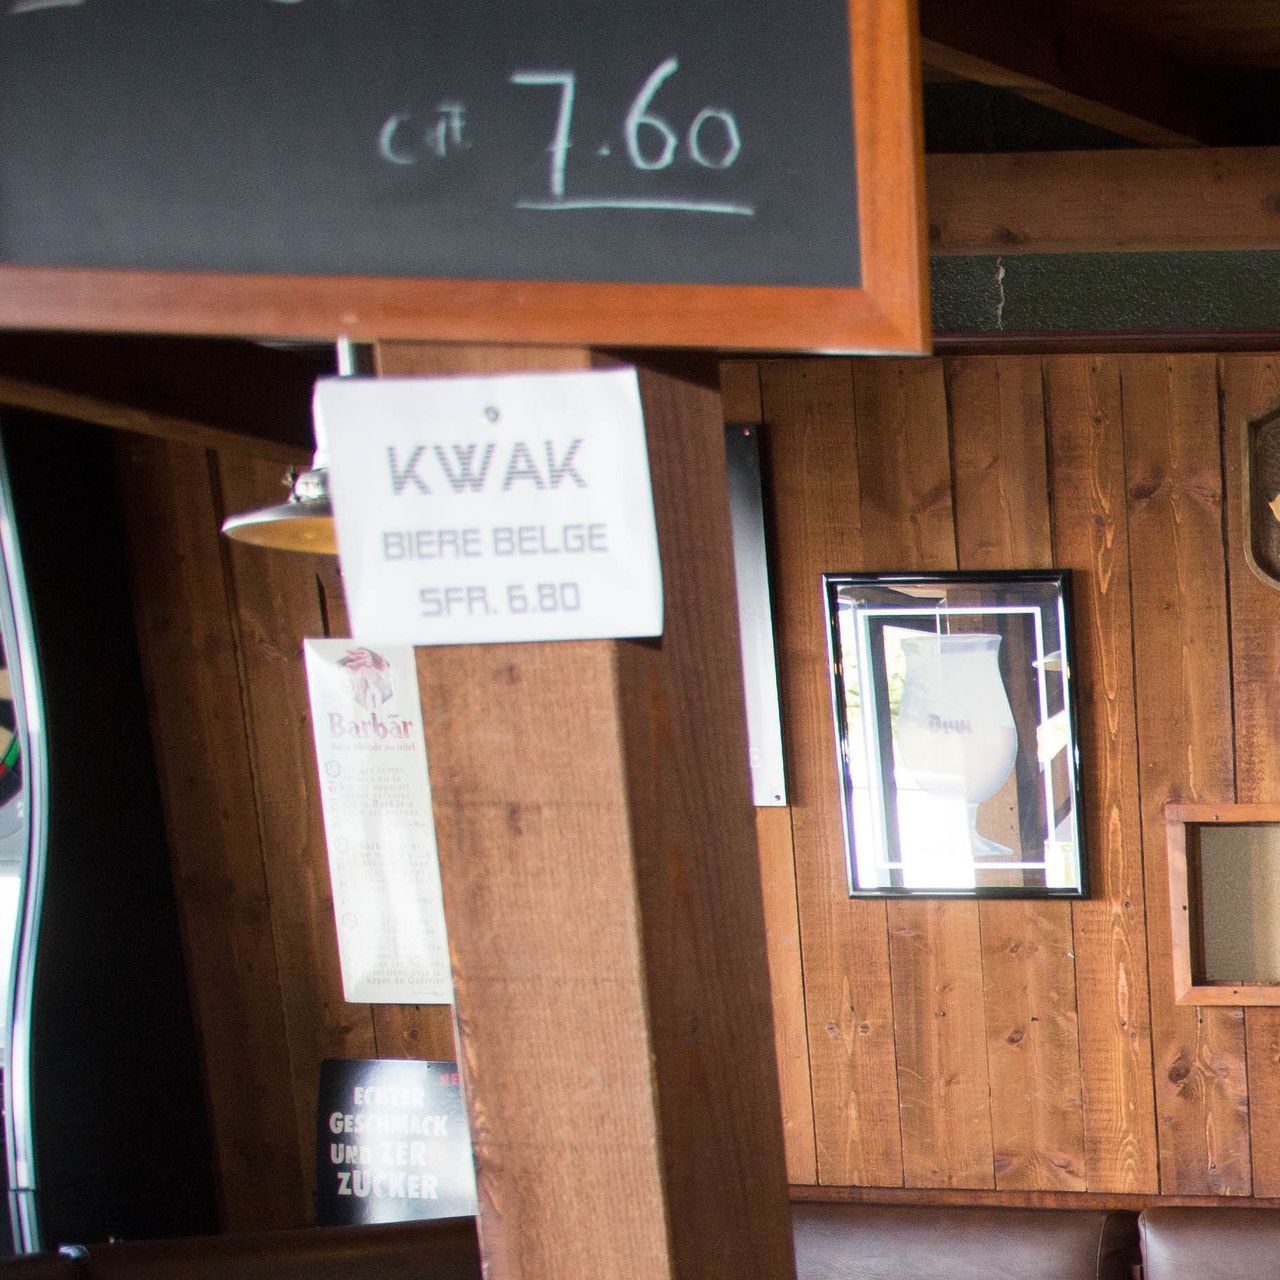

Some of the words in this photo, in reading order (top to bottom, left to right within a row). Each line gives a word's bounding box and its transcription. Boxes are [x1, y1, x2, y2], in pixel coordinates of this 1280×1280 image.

[510, 55, 741, 198] 7.60
[385, 438, 589, 496] KWAK
[382, 527, 482, 562] BIERE
[492, 523, 610, 557] BELGE
[419, 586, 499, 618] SFR.
[506, 581, 582, 614] 6.80
[337, 1170, 439, 1200] ZUCKER
